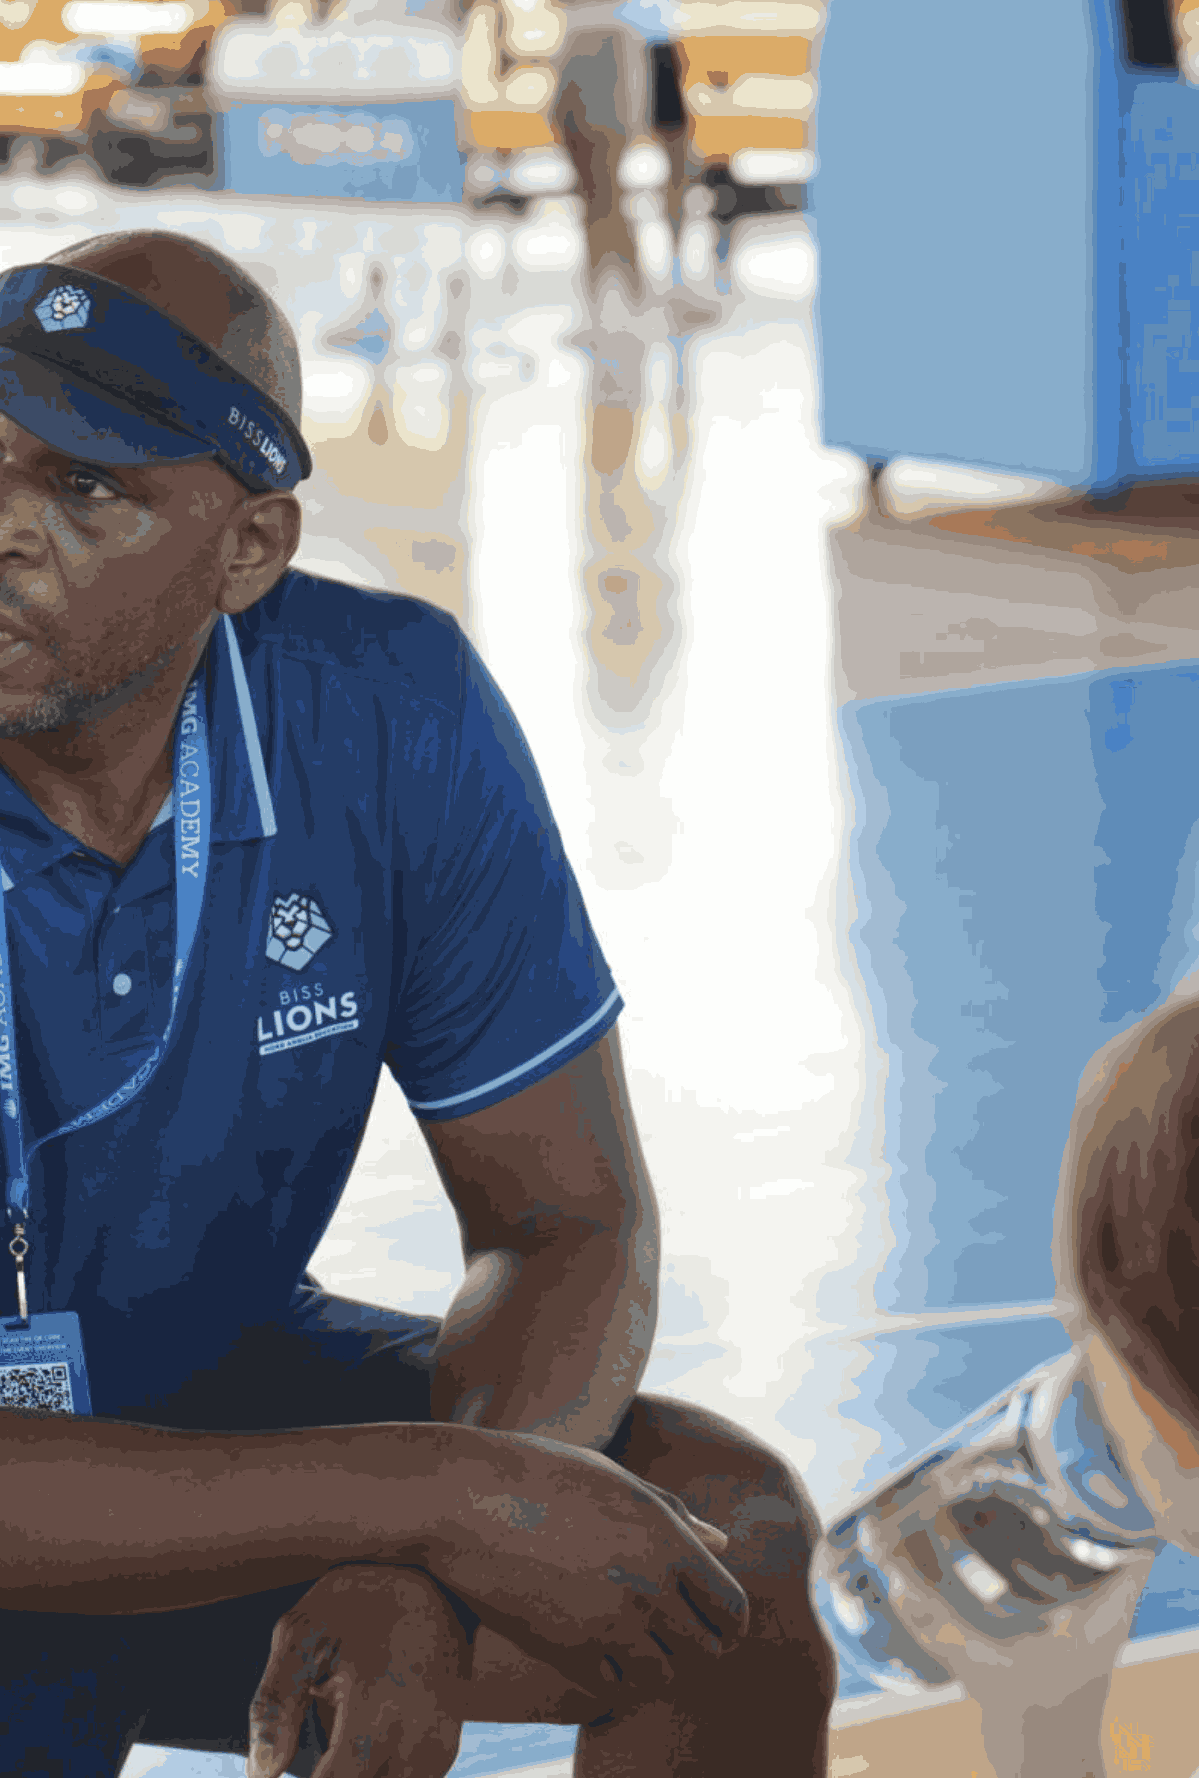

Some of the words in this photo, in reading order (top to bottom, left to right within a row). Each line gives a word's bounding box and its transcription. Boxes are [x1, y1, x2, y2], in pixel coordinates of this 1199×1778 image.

[179, 742, 201, 879] ACADEMY
[258, 991, 359, 1042] LIONS
[279, 982, 324, 1006] BISS
